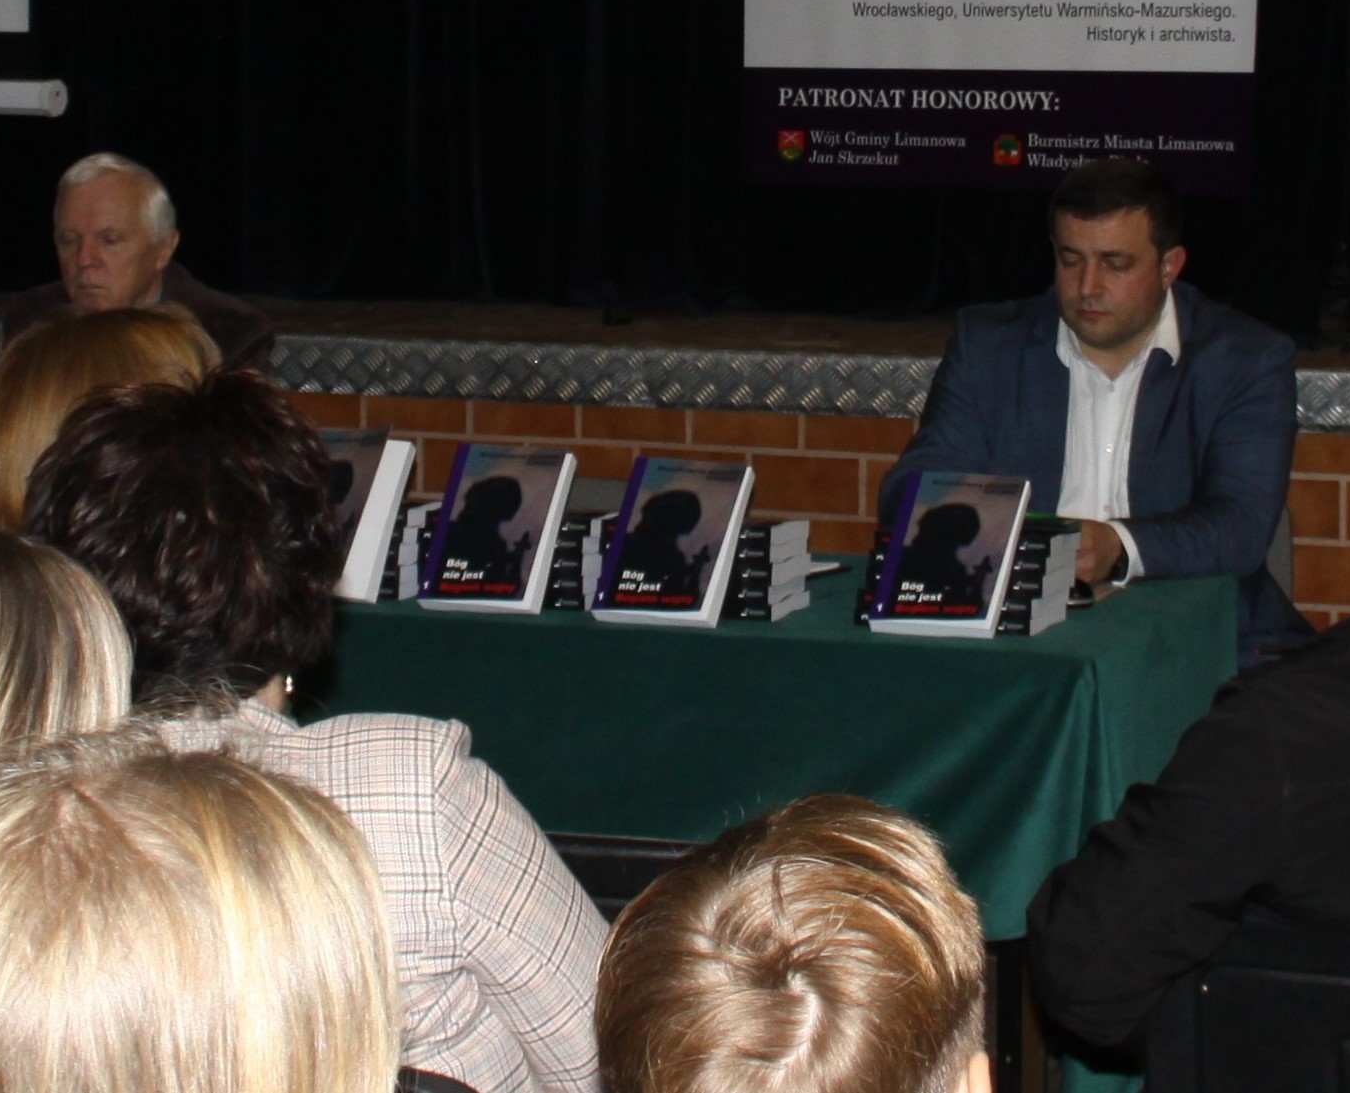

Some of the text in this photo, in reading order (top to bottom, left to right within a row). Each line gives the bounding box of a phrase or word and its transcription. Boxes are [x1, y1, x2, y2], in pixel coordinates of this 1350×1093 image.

[852, 2, 1235, 21] Wrocławskiego, Uniwersytetu Warmińsko-Mazurskiego.
[1087, 26, 1235, 45] Historyk i archiwista.
[778, 88, 1060, 111] PATRONAT HONOROWY:
[810, 130, 966, 149] Wójt Gminy Limanowa
[1027, 133, 1235, 152] Burmistrz Miasta Limanowa
[809, 149, 899, 166] Jan Skrzekut
